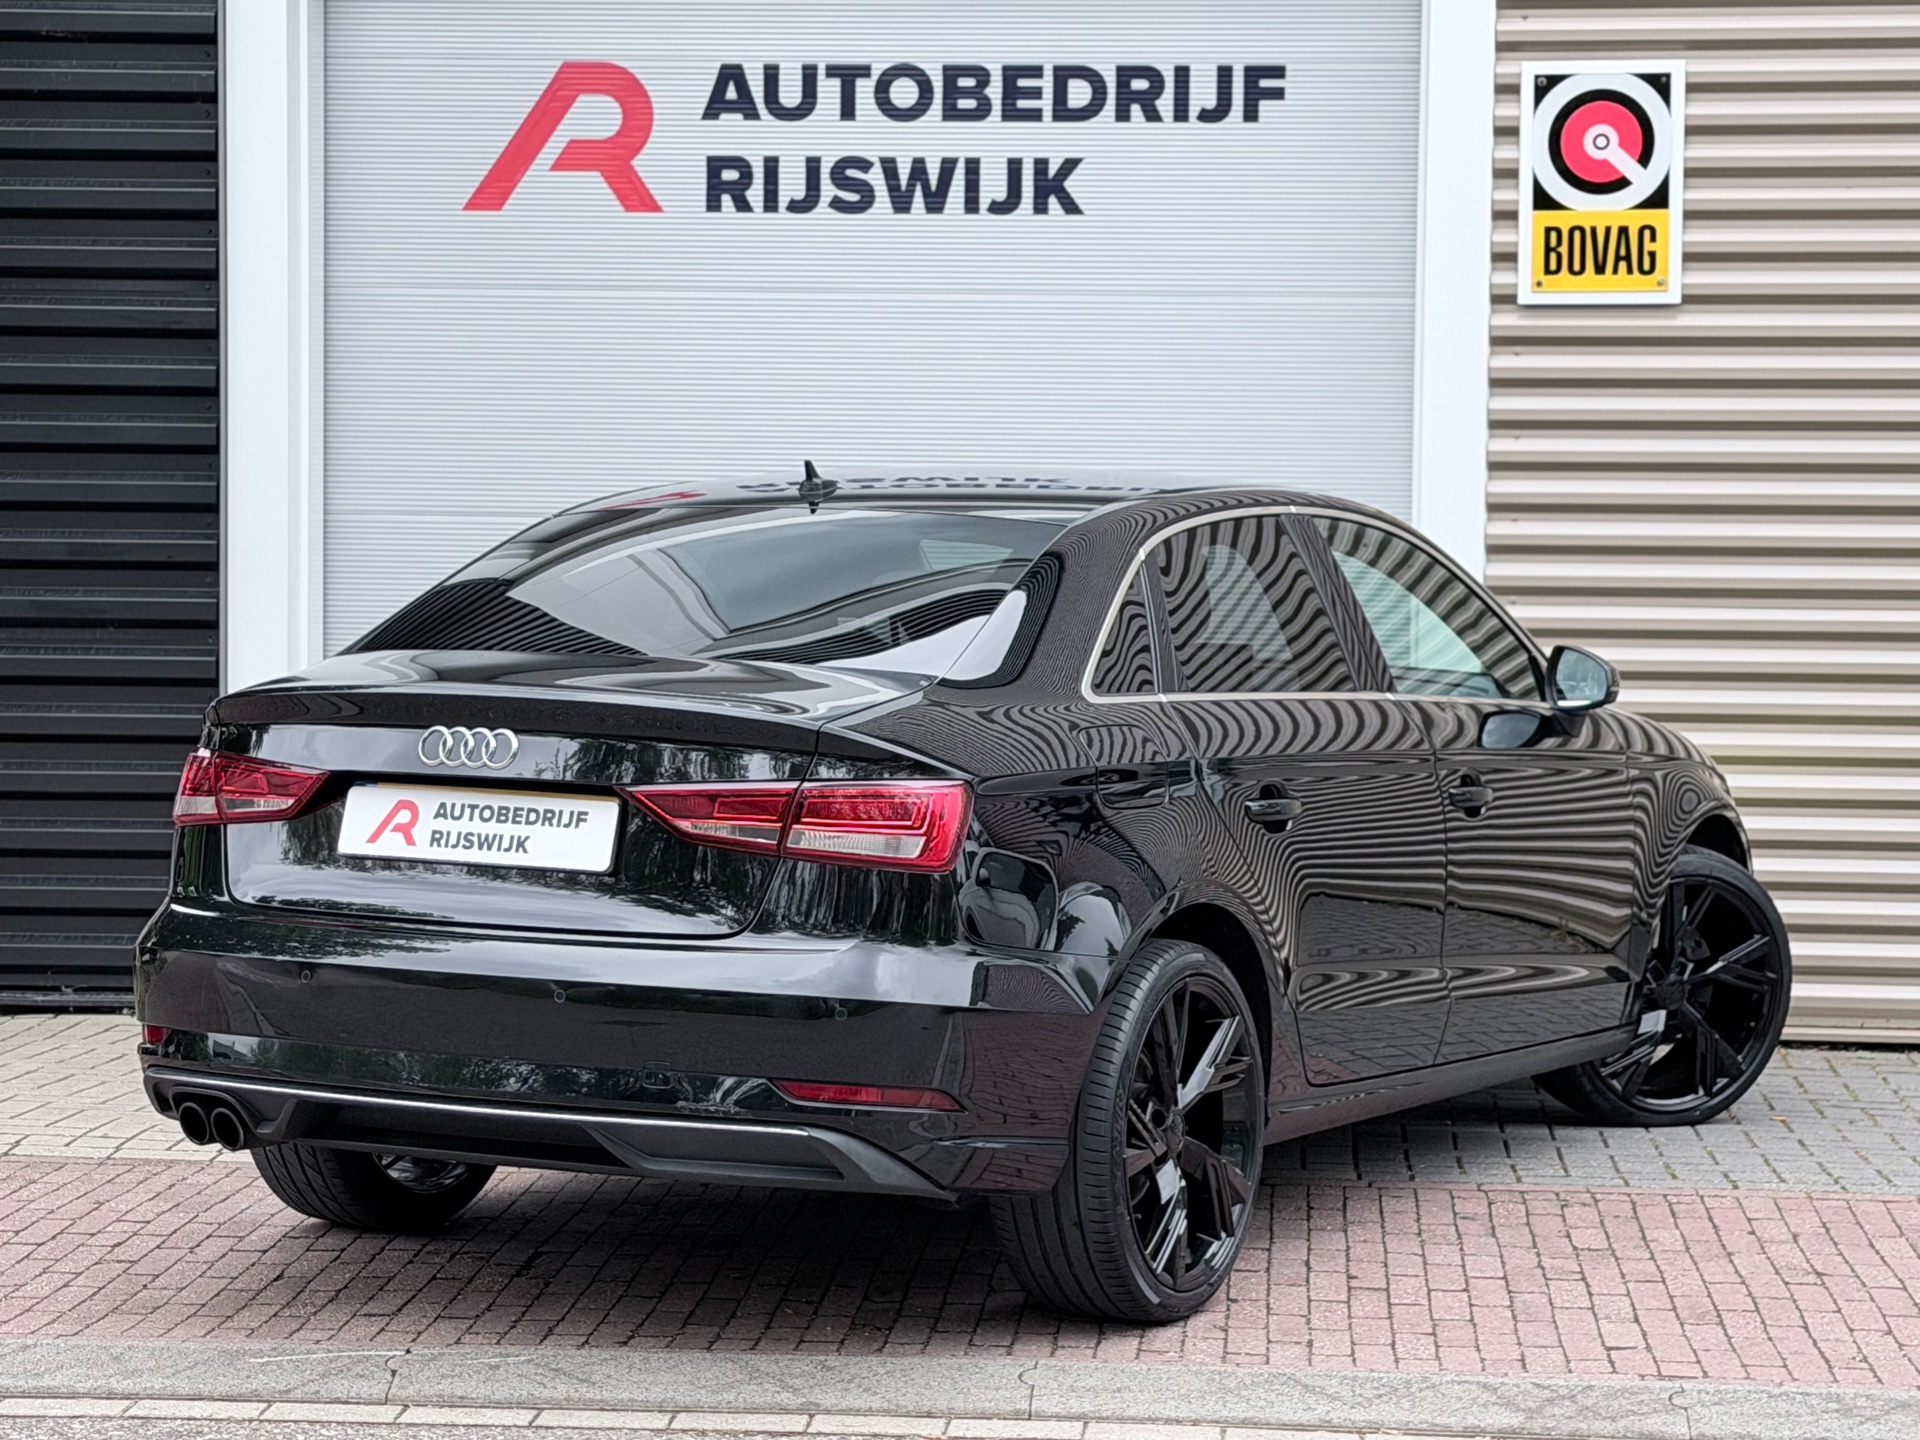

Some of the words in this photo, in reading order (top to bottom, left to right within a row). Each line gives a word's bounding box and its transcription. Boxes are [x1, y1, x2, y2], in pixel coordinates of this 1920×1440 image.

[702, 64, 1287, 123] AUTOBEDRIJF
[705, 155, 1086, 215] RIJSWIJK
[1544, 225, 1657, 276] BOVAG
[433, 802, 589, 829] AUTOBEDRIJF
[429, 829, 531, 854] RIJSWIJK
